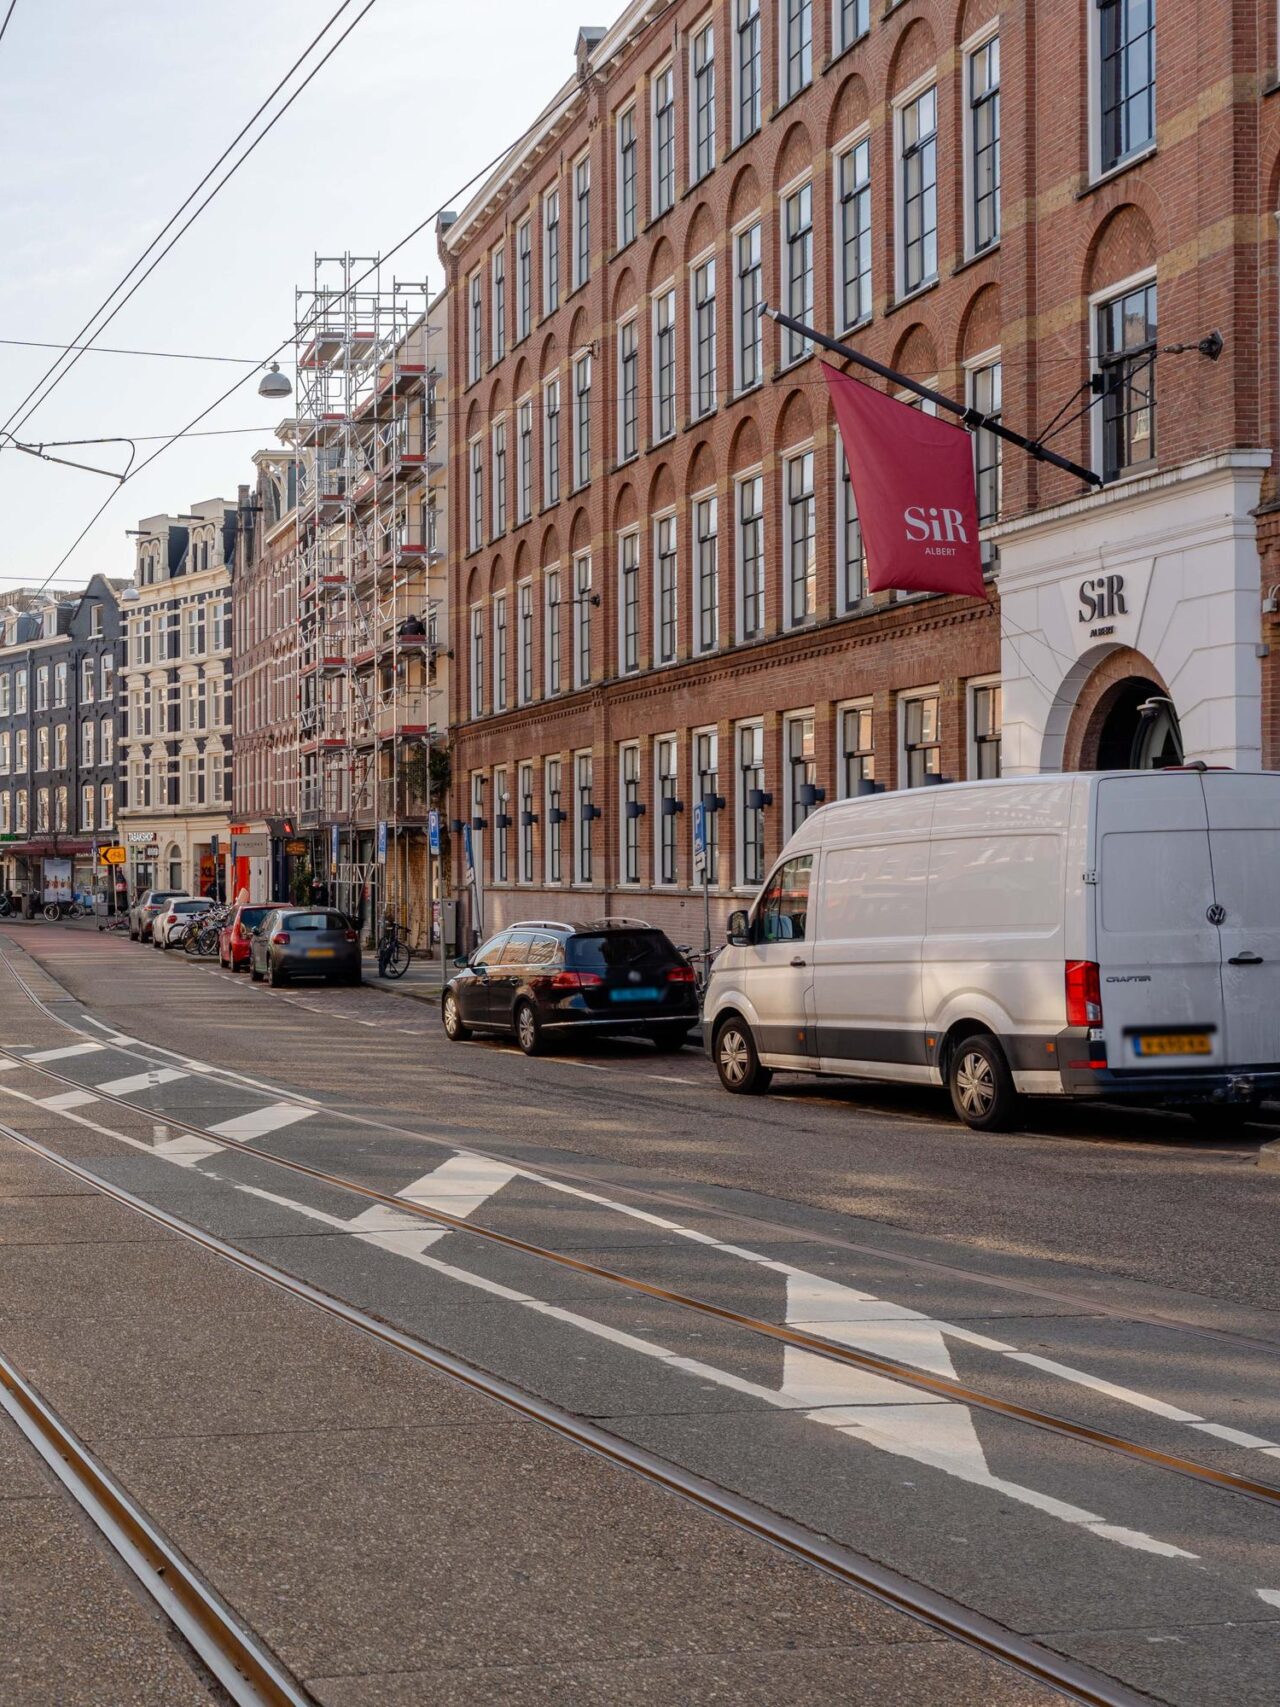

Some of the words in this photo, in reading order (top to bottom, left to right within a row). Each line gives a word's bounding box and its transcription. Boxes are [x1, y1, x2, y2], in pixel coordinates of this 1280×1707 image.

[904, 506, 969, 544] SiR
[925, 547, 956, 556] ALBERT
[1078, 575, 1128, 622] SiR
[1105, 975, 1151, 983] CRAFTER
